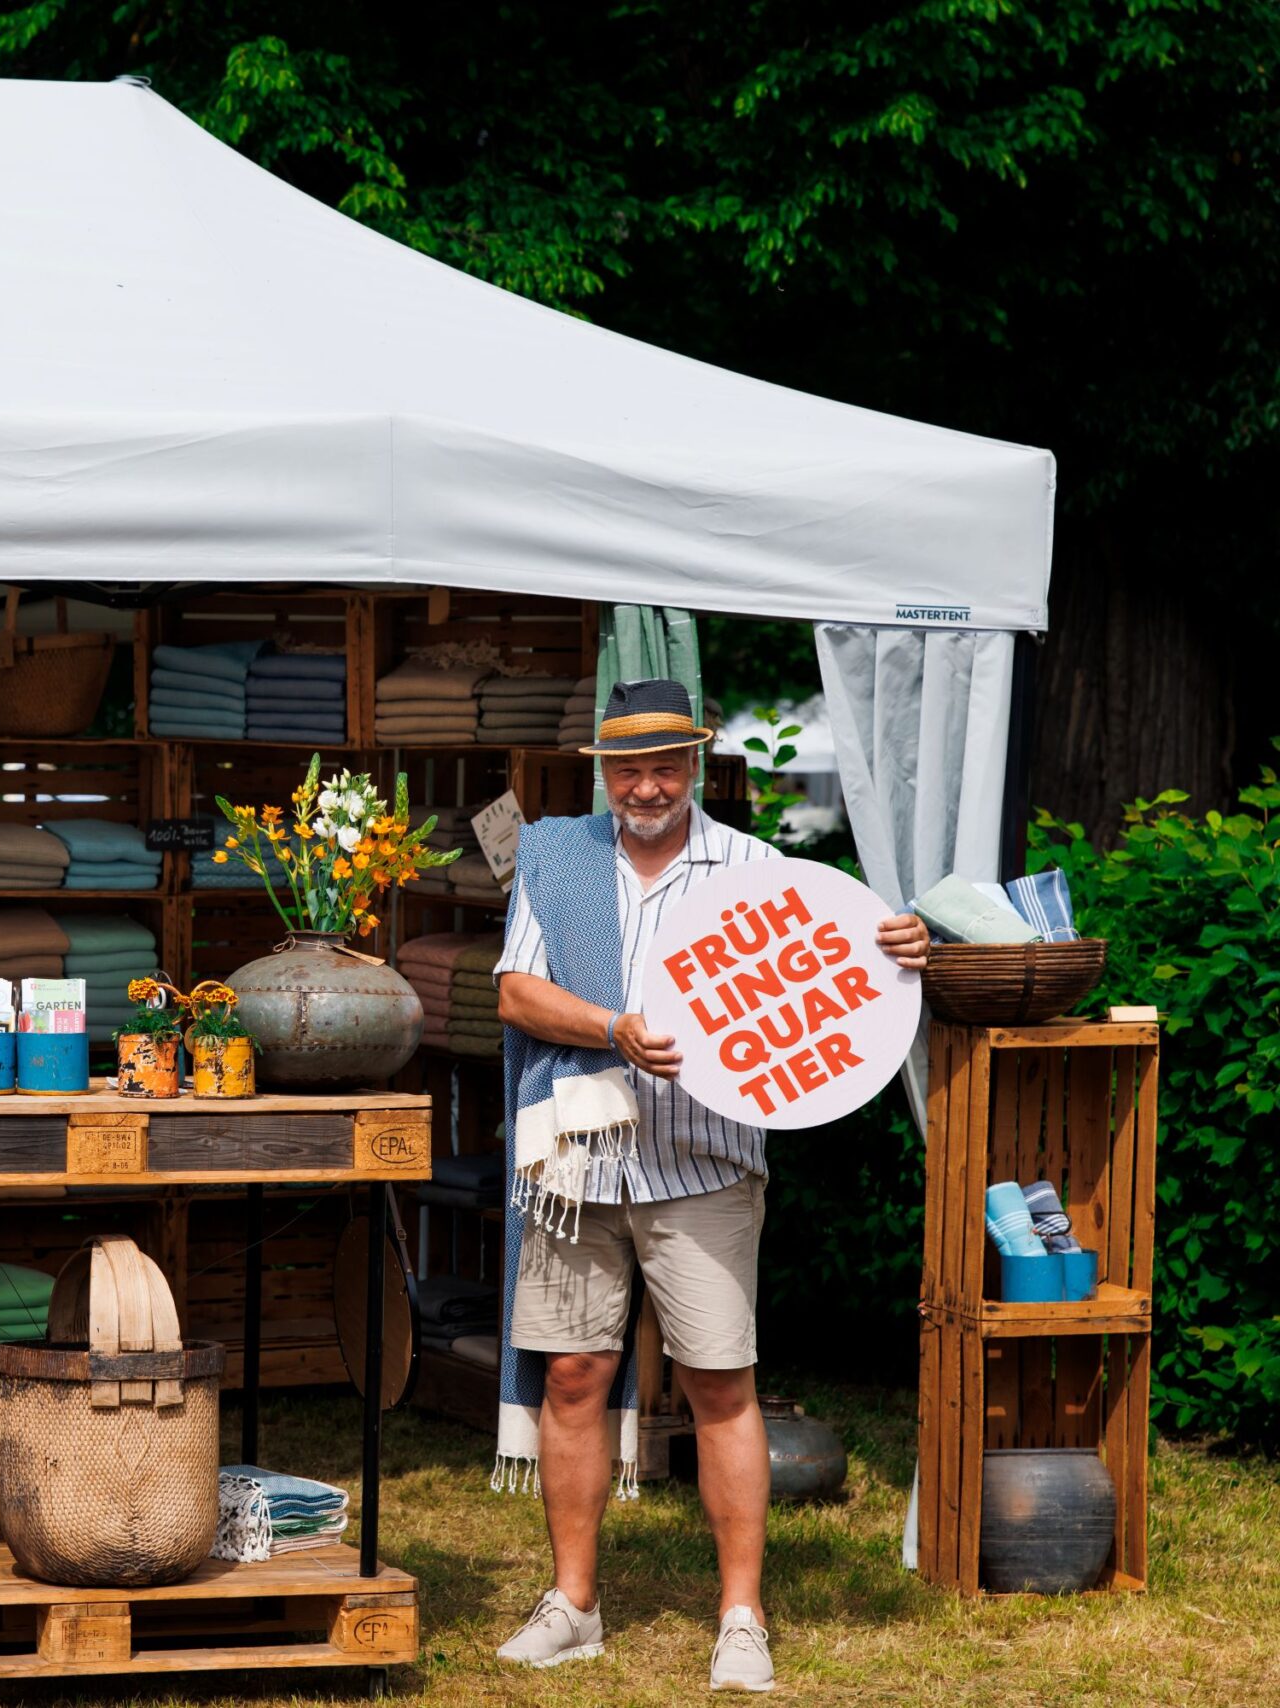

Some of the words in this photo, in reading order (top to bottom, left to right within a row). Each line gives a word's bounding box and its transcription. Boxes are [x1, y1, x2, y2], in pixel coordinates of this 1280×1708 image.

[896, 609, 971, 621] MASTERTENT
[663, 886, 813, 994] FRÜH
[688, 921, 851, 1036] LINGS
[36, 1001, 82, 1011] GARTEN
[719, 966, 882, 1072] QUAR
[738, 1033, 865, 1116] TIER
[379, 1136, 418, 1156] EPAL
